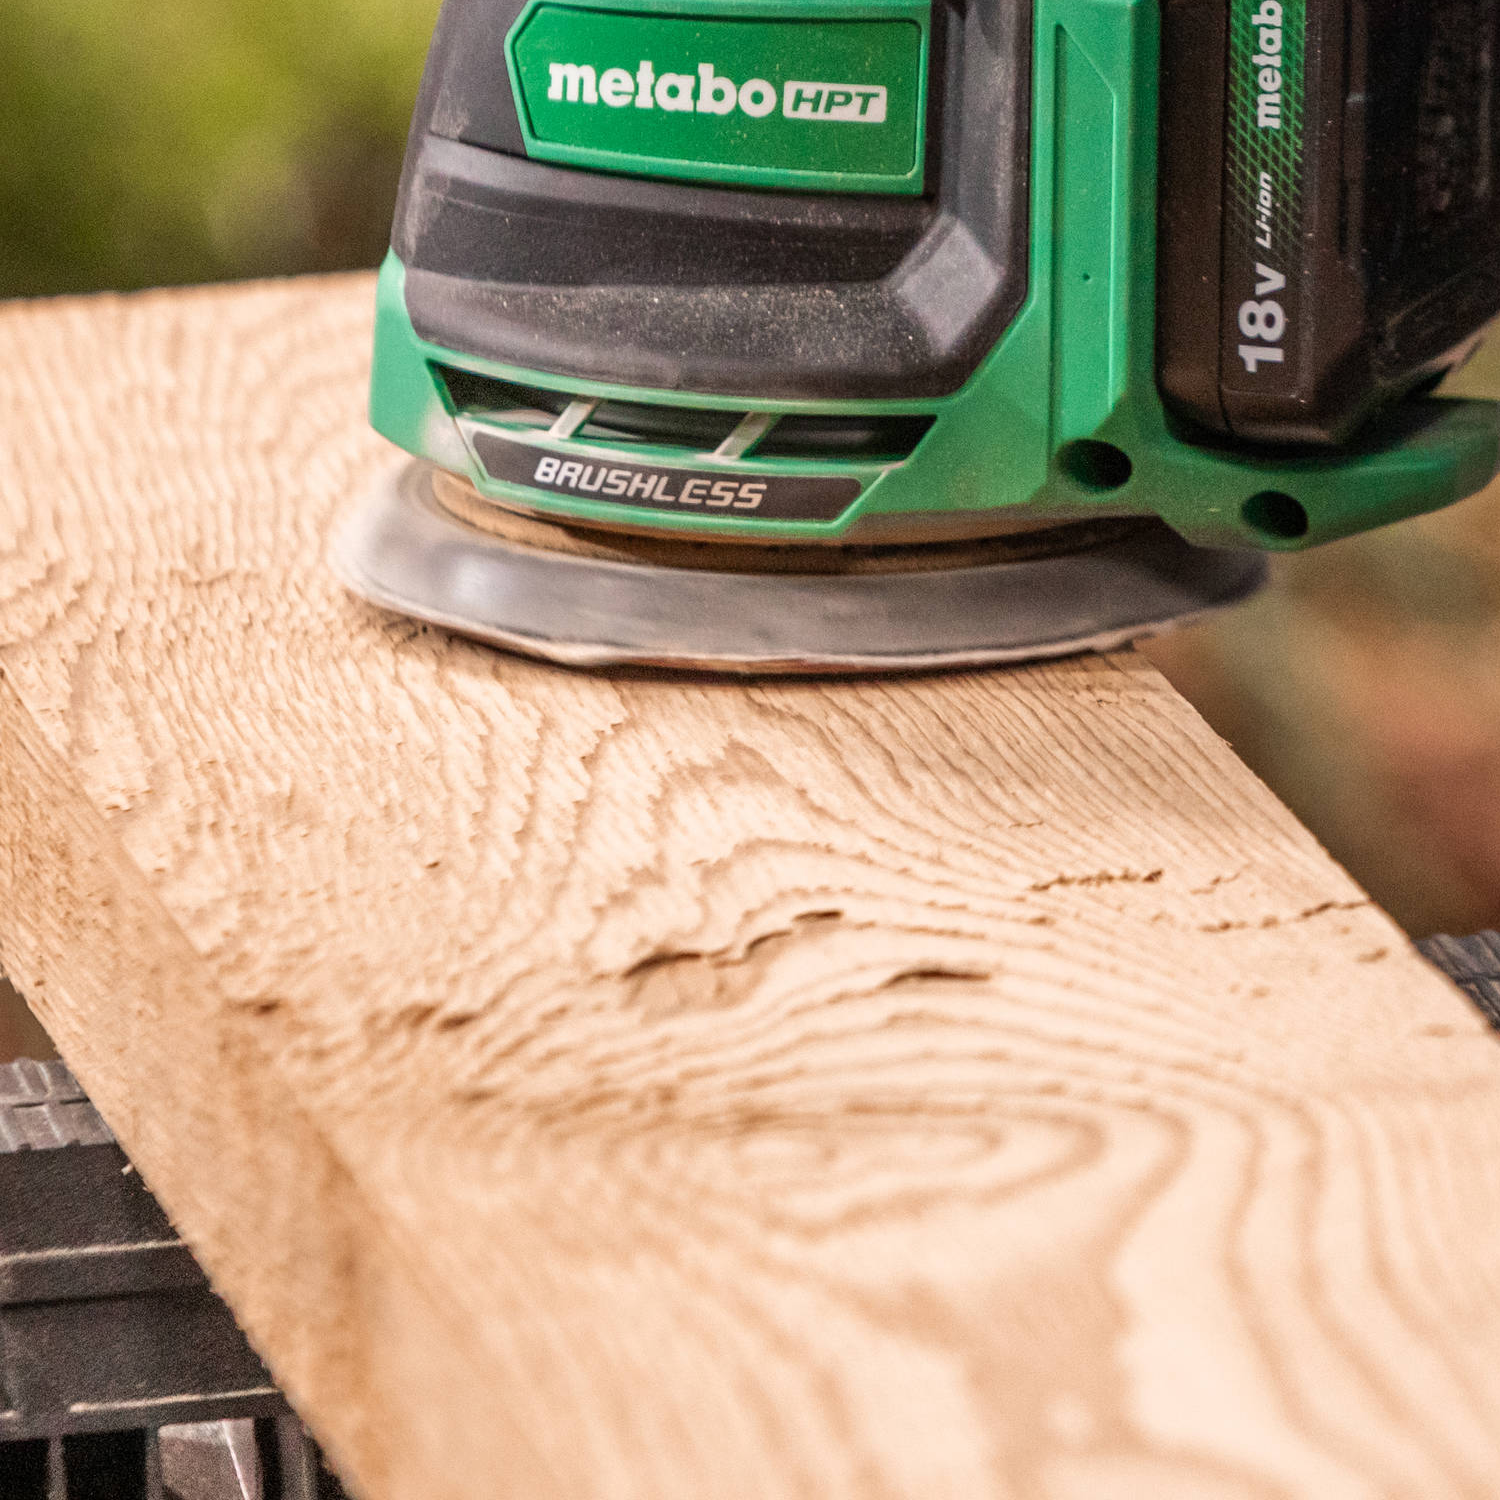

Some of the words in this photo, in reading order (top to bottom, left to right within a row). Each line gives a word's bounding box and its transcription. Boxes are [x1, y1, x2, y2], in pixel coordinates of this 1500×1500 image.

[547, 60, 778, 118] metabo
[790, 86, 881, 117] HPT
[533, 456, 768, 509] BRUSHLESS
